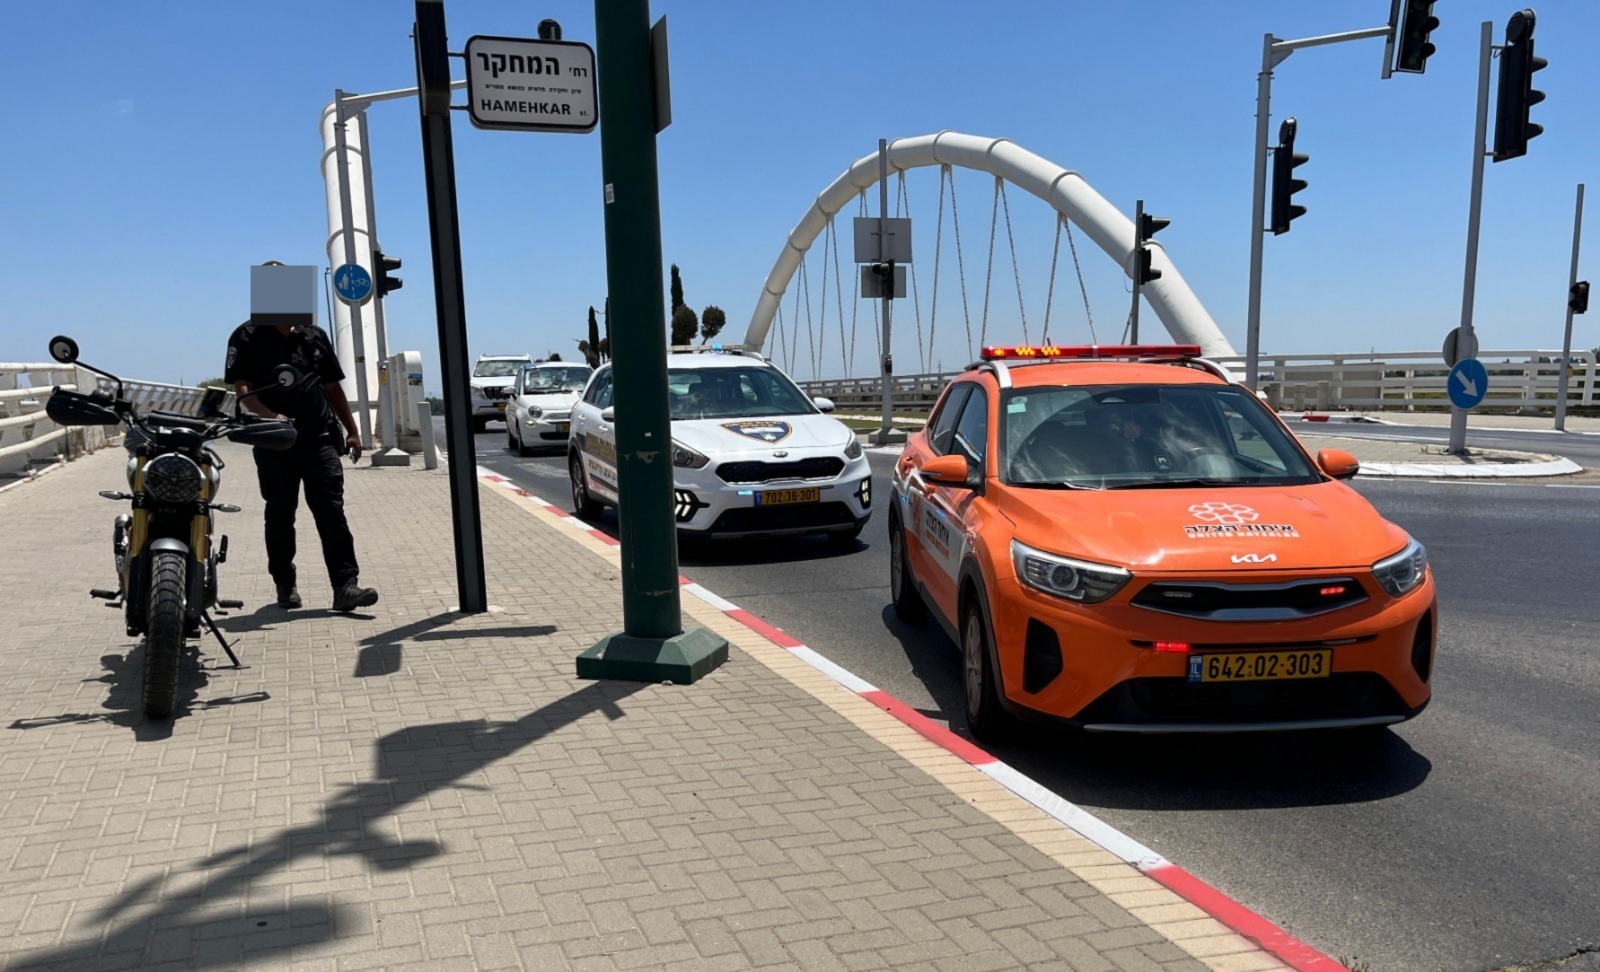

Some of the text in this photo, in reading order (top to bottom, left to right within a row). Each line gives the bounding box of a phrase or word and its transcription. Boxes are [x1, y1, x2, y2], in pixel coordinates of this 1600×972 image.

[477, 52, 560, 78] המחקר
[481, 98, 571, 115] HAMEHKAR
[1184, 524, 1295, 533] איחוד הצלה
